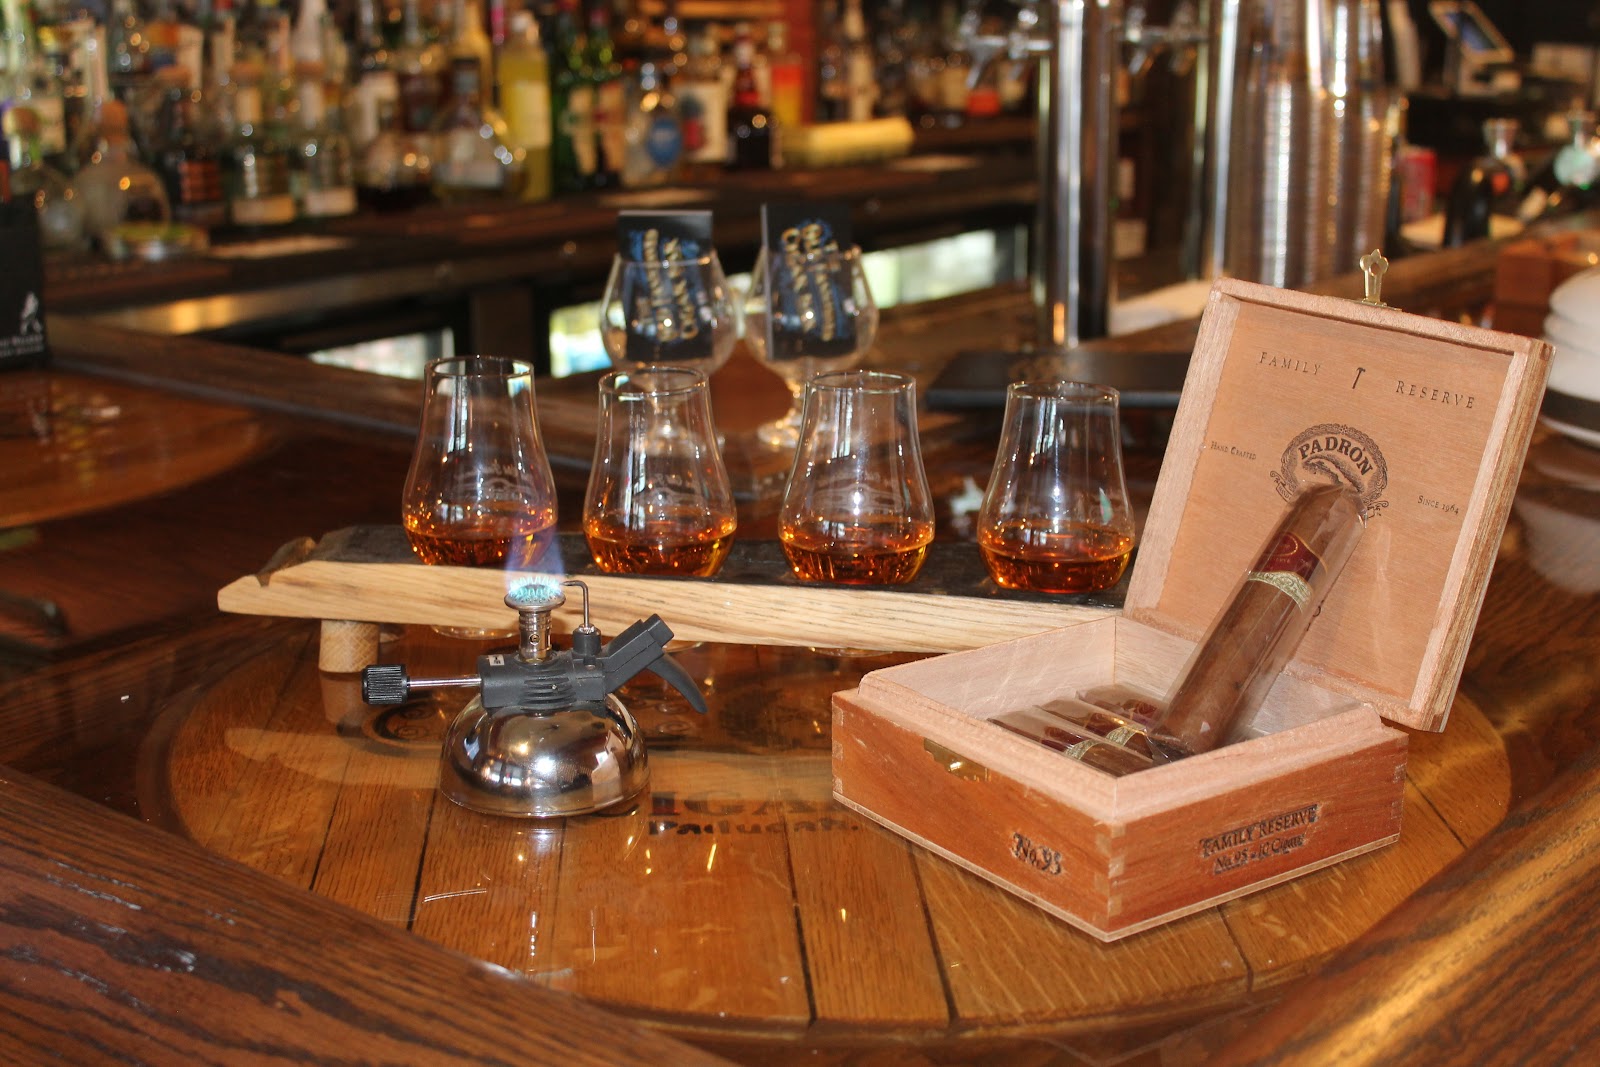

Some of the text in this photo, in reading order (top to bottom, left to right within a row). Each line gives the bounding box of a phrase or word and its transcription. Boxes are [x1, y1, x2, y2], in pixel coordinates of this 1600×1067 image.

[1259, 351, 1475, 409] FAMILY RESERVE
[1441, 503, 1459, 515] 1964
[1199, 804, 1318, 858] FAMILY RESERVE
